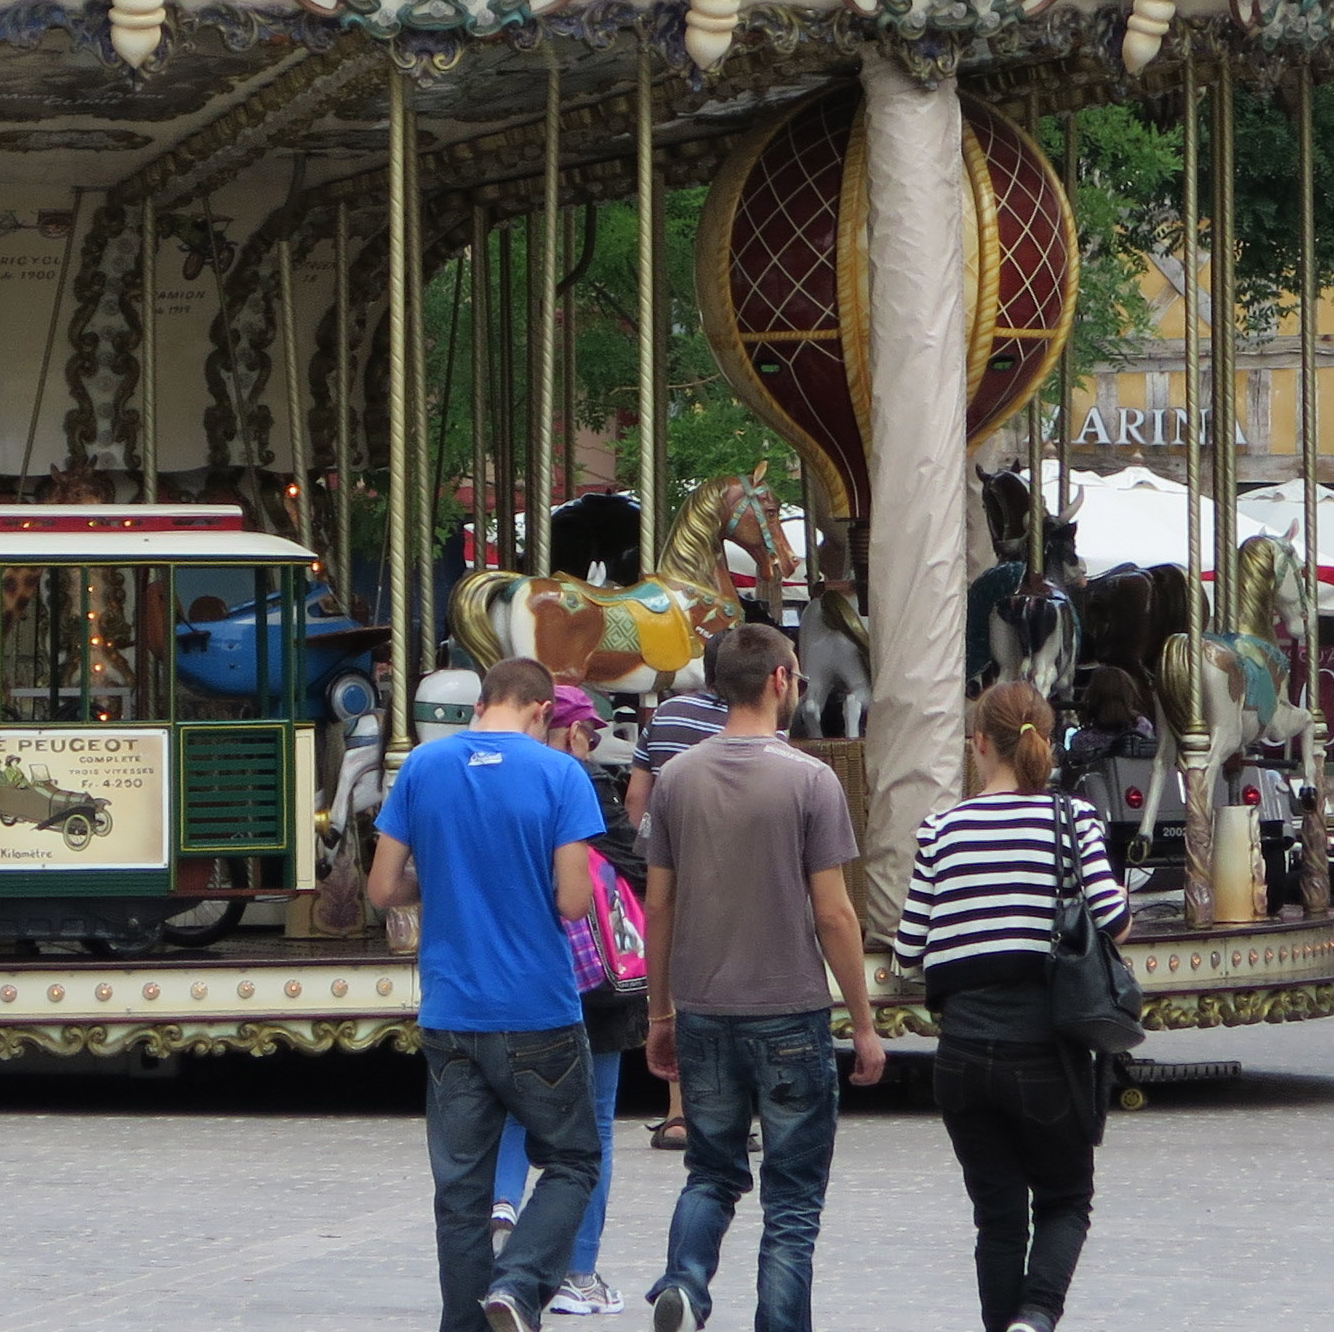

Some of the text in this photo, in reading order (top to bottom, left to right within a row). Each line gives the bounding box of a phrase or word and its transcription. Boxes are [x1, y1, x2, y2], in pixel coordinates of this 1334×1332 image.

[1024, 405, 1248, 446] ARIN
[18, 738, 139, 753] PEUGEOT
[104, 767, 155, 775] VITESSES
